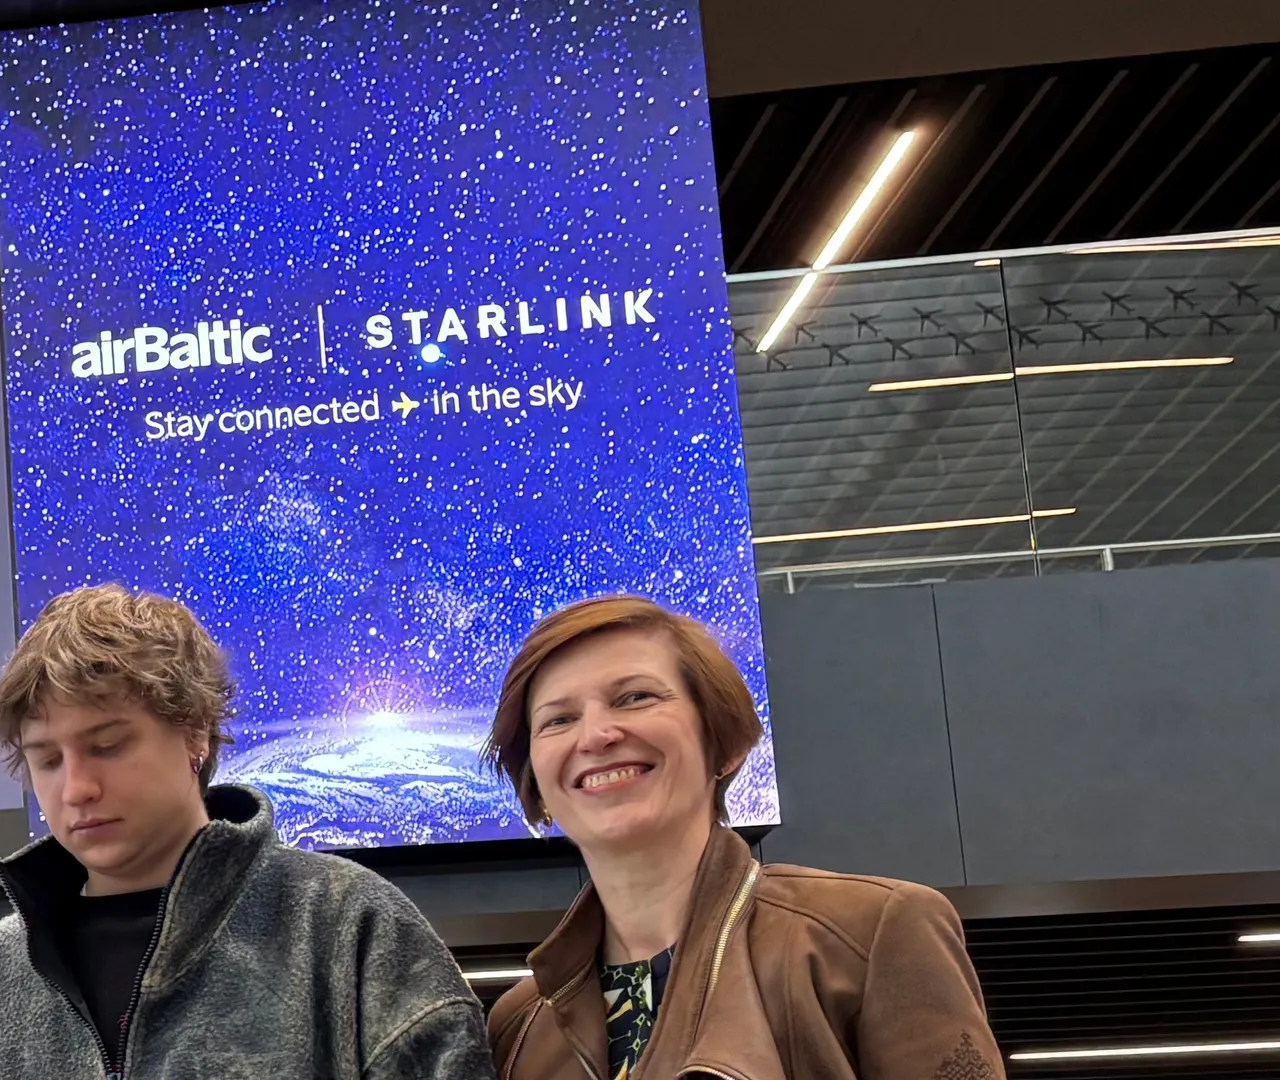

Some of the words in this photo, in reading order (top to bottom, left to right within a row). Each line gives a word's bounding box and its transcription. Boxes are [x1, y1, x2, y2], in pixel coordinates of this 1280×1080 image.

[71, 320, 273, 378] airBaltic
[365, 288, 658, 349] STARLINK
[145, 412, 210, 442] Stay
[217, 393, 380, 434] connected
[432, 387, 461, 414] in
[467, 381, 522, 412] the
[529, 378, 584, 409] sky
